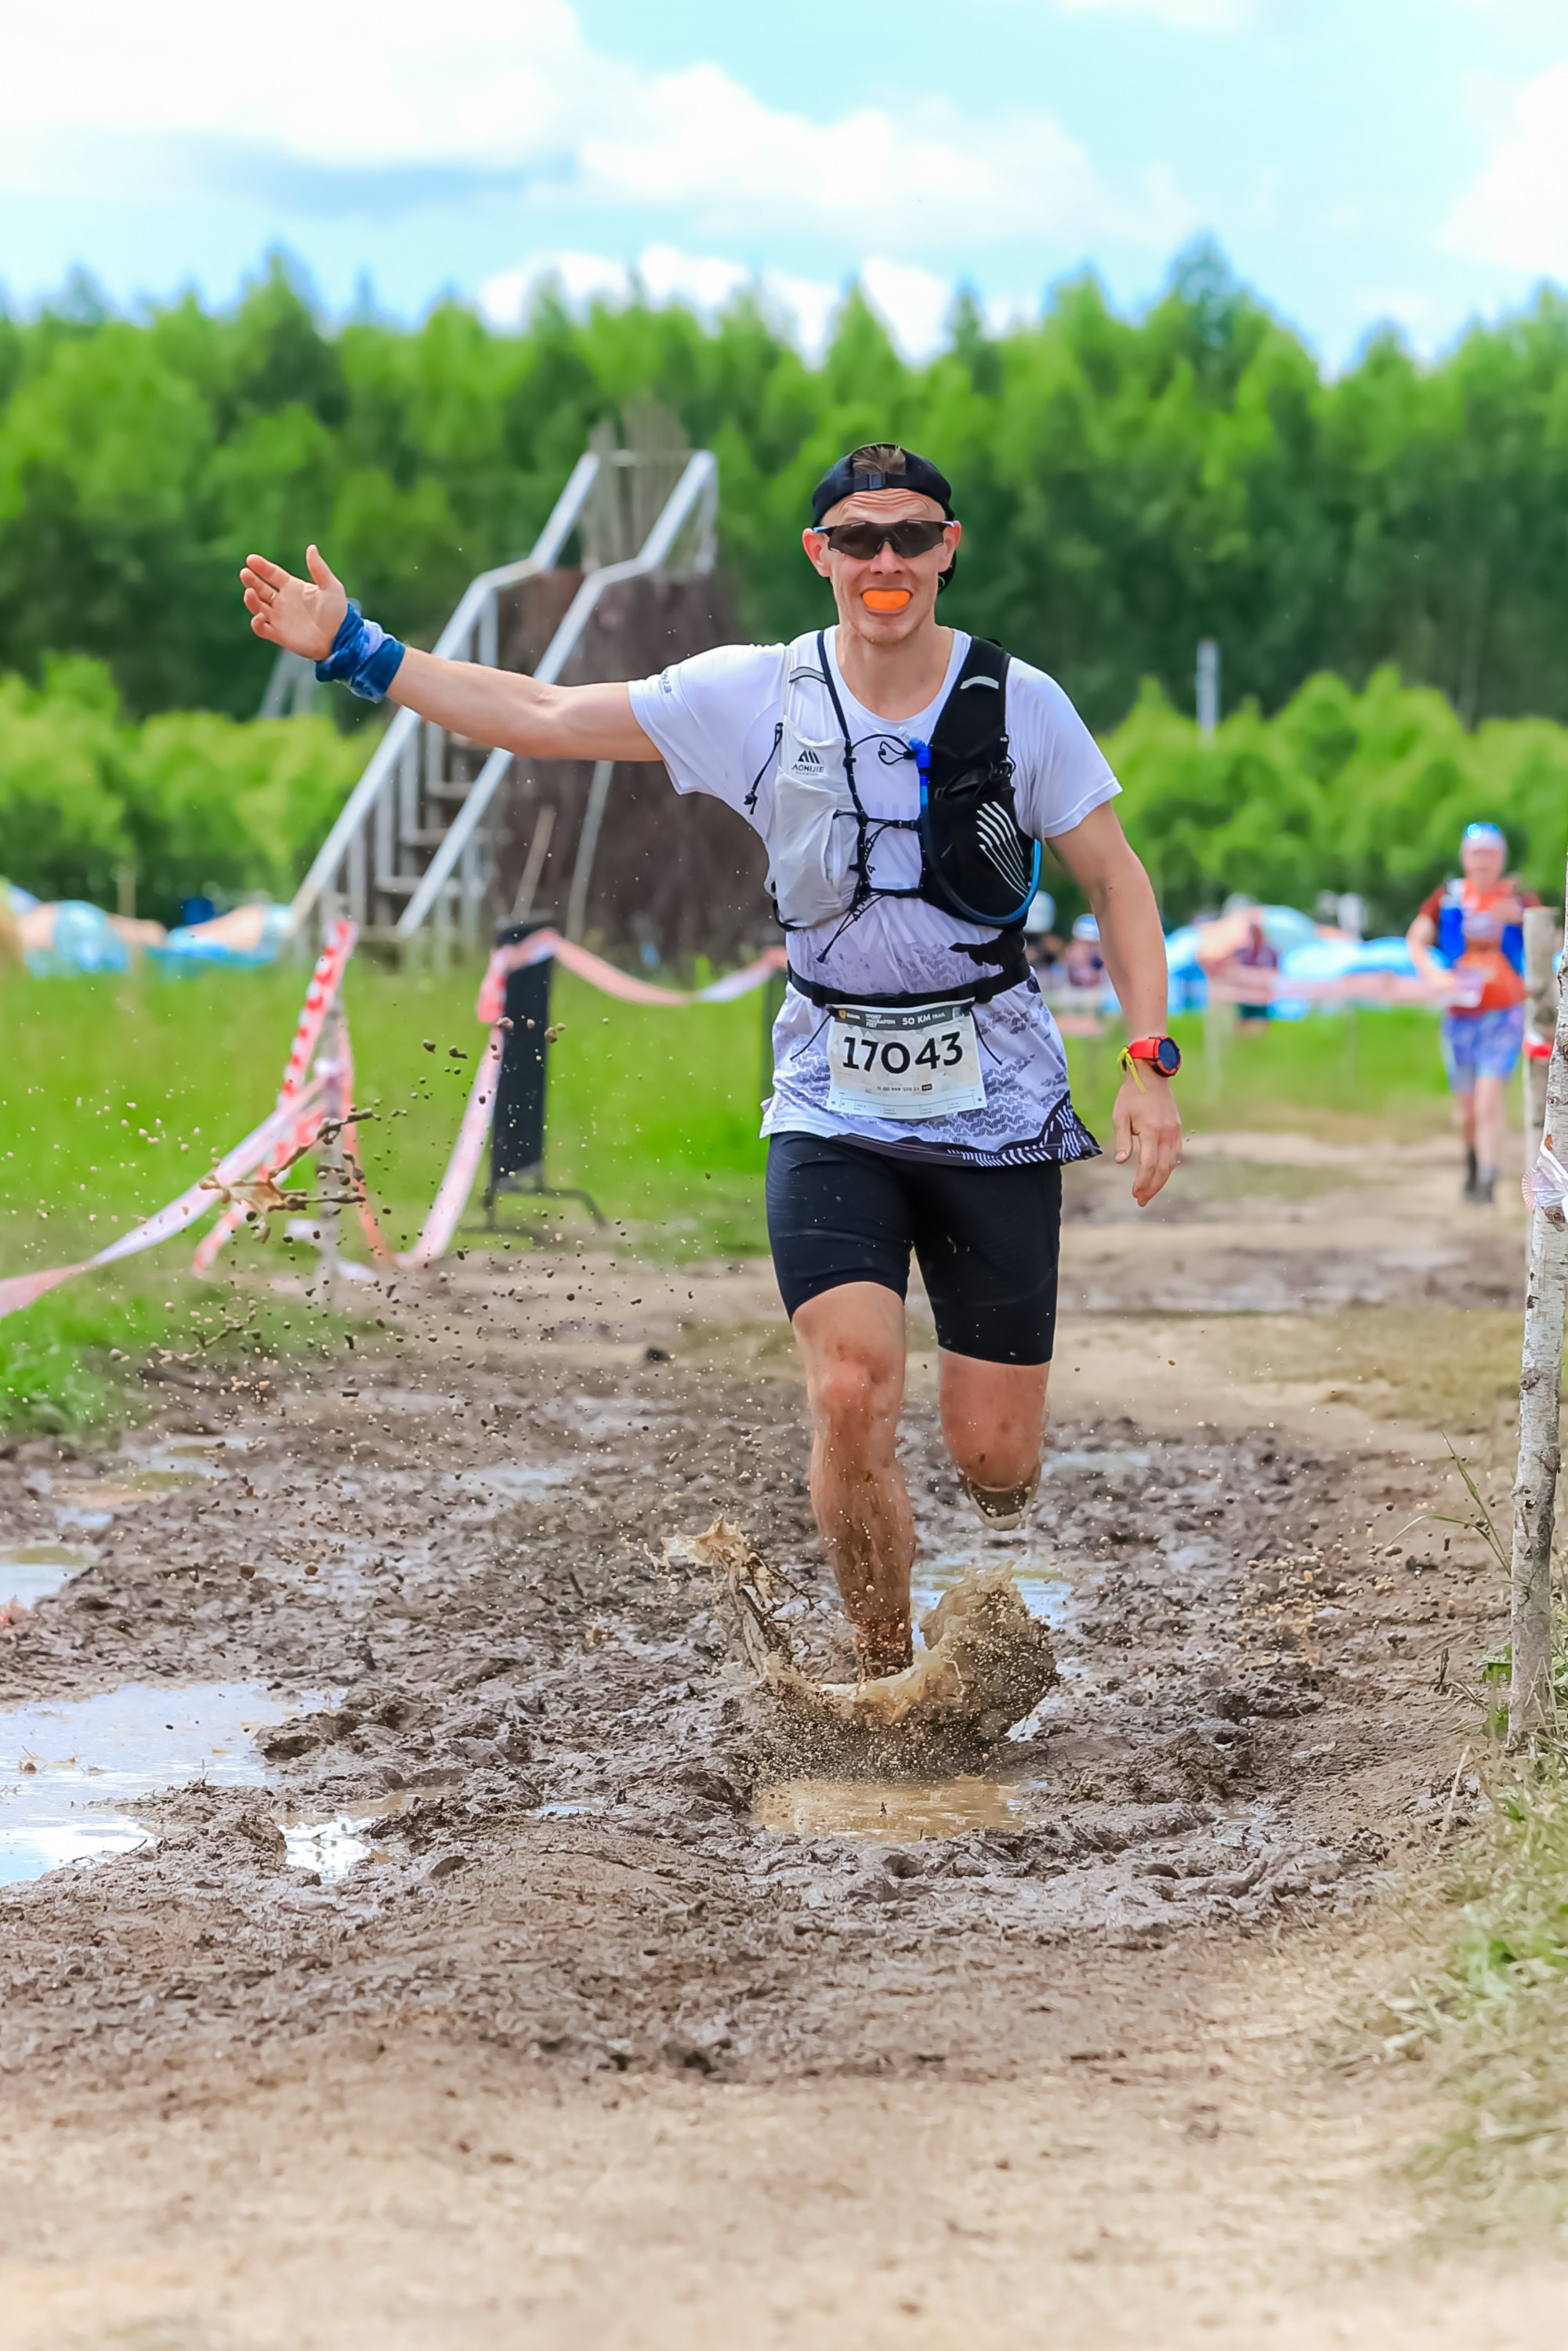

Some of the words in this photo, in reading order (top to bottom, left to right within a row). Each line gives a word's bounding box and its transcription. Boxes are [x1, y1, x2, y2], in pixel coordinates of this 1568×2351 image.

[791, 763, 824, 773] AONIJIE
[902, 1016, 915, 1026] 50
[917, 1013, 931, 1023] KM
[842, 1031, 963, 1074] 17043
